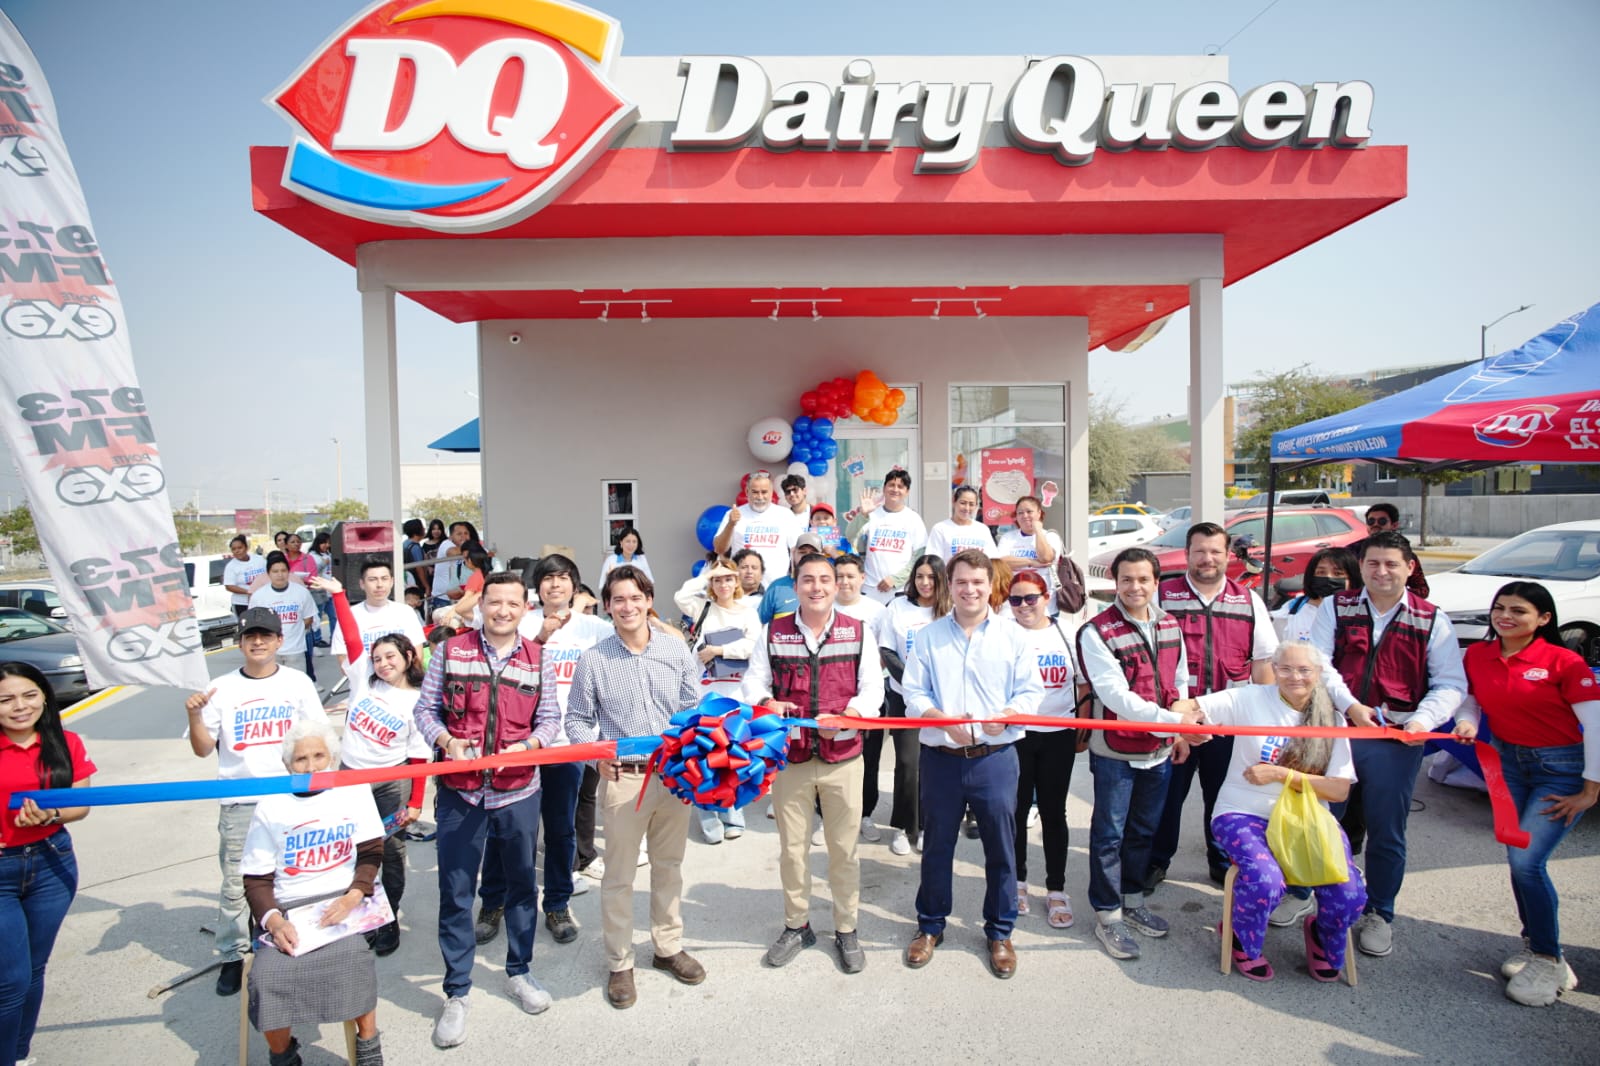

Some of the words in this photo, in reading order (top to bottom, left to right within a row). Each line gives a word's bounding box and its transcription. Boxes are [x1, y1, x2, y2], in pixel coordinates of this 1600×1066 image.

[332, 37, 571, 171] DQ
[671, 54, 993, 173] Dairy
[1007, 54, 1375, 162] Queen
[1483, 413, 1542, 437] DQ
[1570, 418, 1595, 433] EL
[749, 533, 767, 544] FAN
[768, 534, 780, 545] 47
[876, 537, 892, 548] FAN
[893, 538, 905, 551] 32
[1037, 654, 1066, 667] ZARD
[1050, 666, 1067, 684] 02
[235, 705, 294, 724] BLIZZARD
[355, 711, 380, 735] FAN
[358, 697, 406, 731] BLIZZARD
[244, 721, 273, 740] FAN
[285, 822, 355, 852] BLIZZARD
[295, 844, 331, 867] FAN
